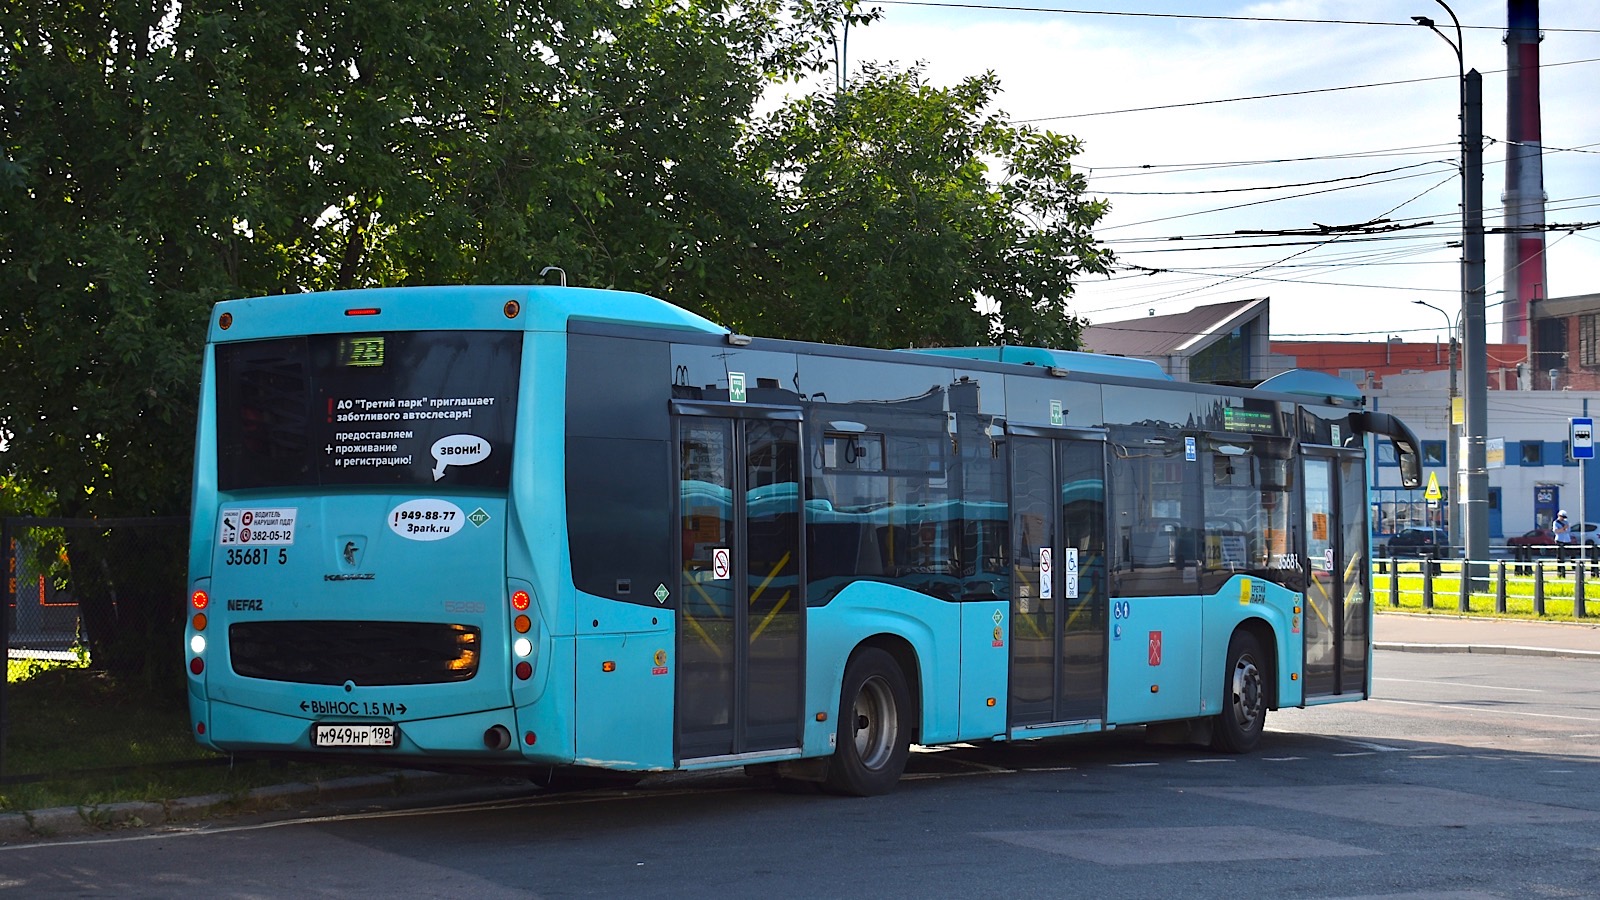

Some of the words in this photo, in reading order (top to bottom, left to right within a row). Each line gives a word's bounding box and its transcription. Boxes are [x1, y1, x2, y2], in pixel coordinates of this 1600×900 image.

[337, 400, 353, 410] АО
[355, 399, 396, 411] "Третий
[398, 397, 428, 410] парк"
[430, 397, 495, 409] приглашает
[337, 412, 400, 422] заботливого
[402, 409, 472, 421] автослесаря!
[335, 430, 413, 442] предоставляем
[335, 444, 398, 454] проживание
[440, 443, 482, 455] звони!
[335, 458, 342, 466] и
[343, 455, 412, 468] регистрацию!
[401, 511, 456, 520] 949-88-77
[280, 518, 294, 526] ПДД?
[407, 523, 450, 534] 3park.ru
[252, 530, 292, 541] 382-05-12
[226, 548, 268, 566] 35681
[278, 548, 288, 565] 5
[1278, 553, 1298, 569] 35681
[227, 599, 263, 611] NEFAZ
[444, 600, 486, 613] 5299
[311, 701, 359, 715] ВЫНОС
[363, 702, 380, 715] 1.5
[382, 703, 395, 716] М
[320, 728, 369, 743] М949НР
[371, 727, 390, 739] 198
